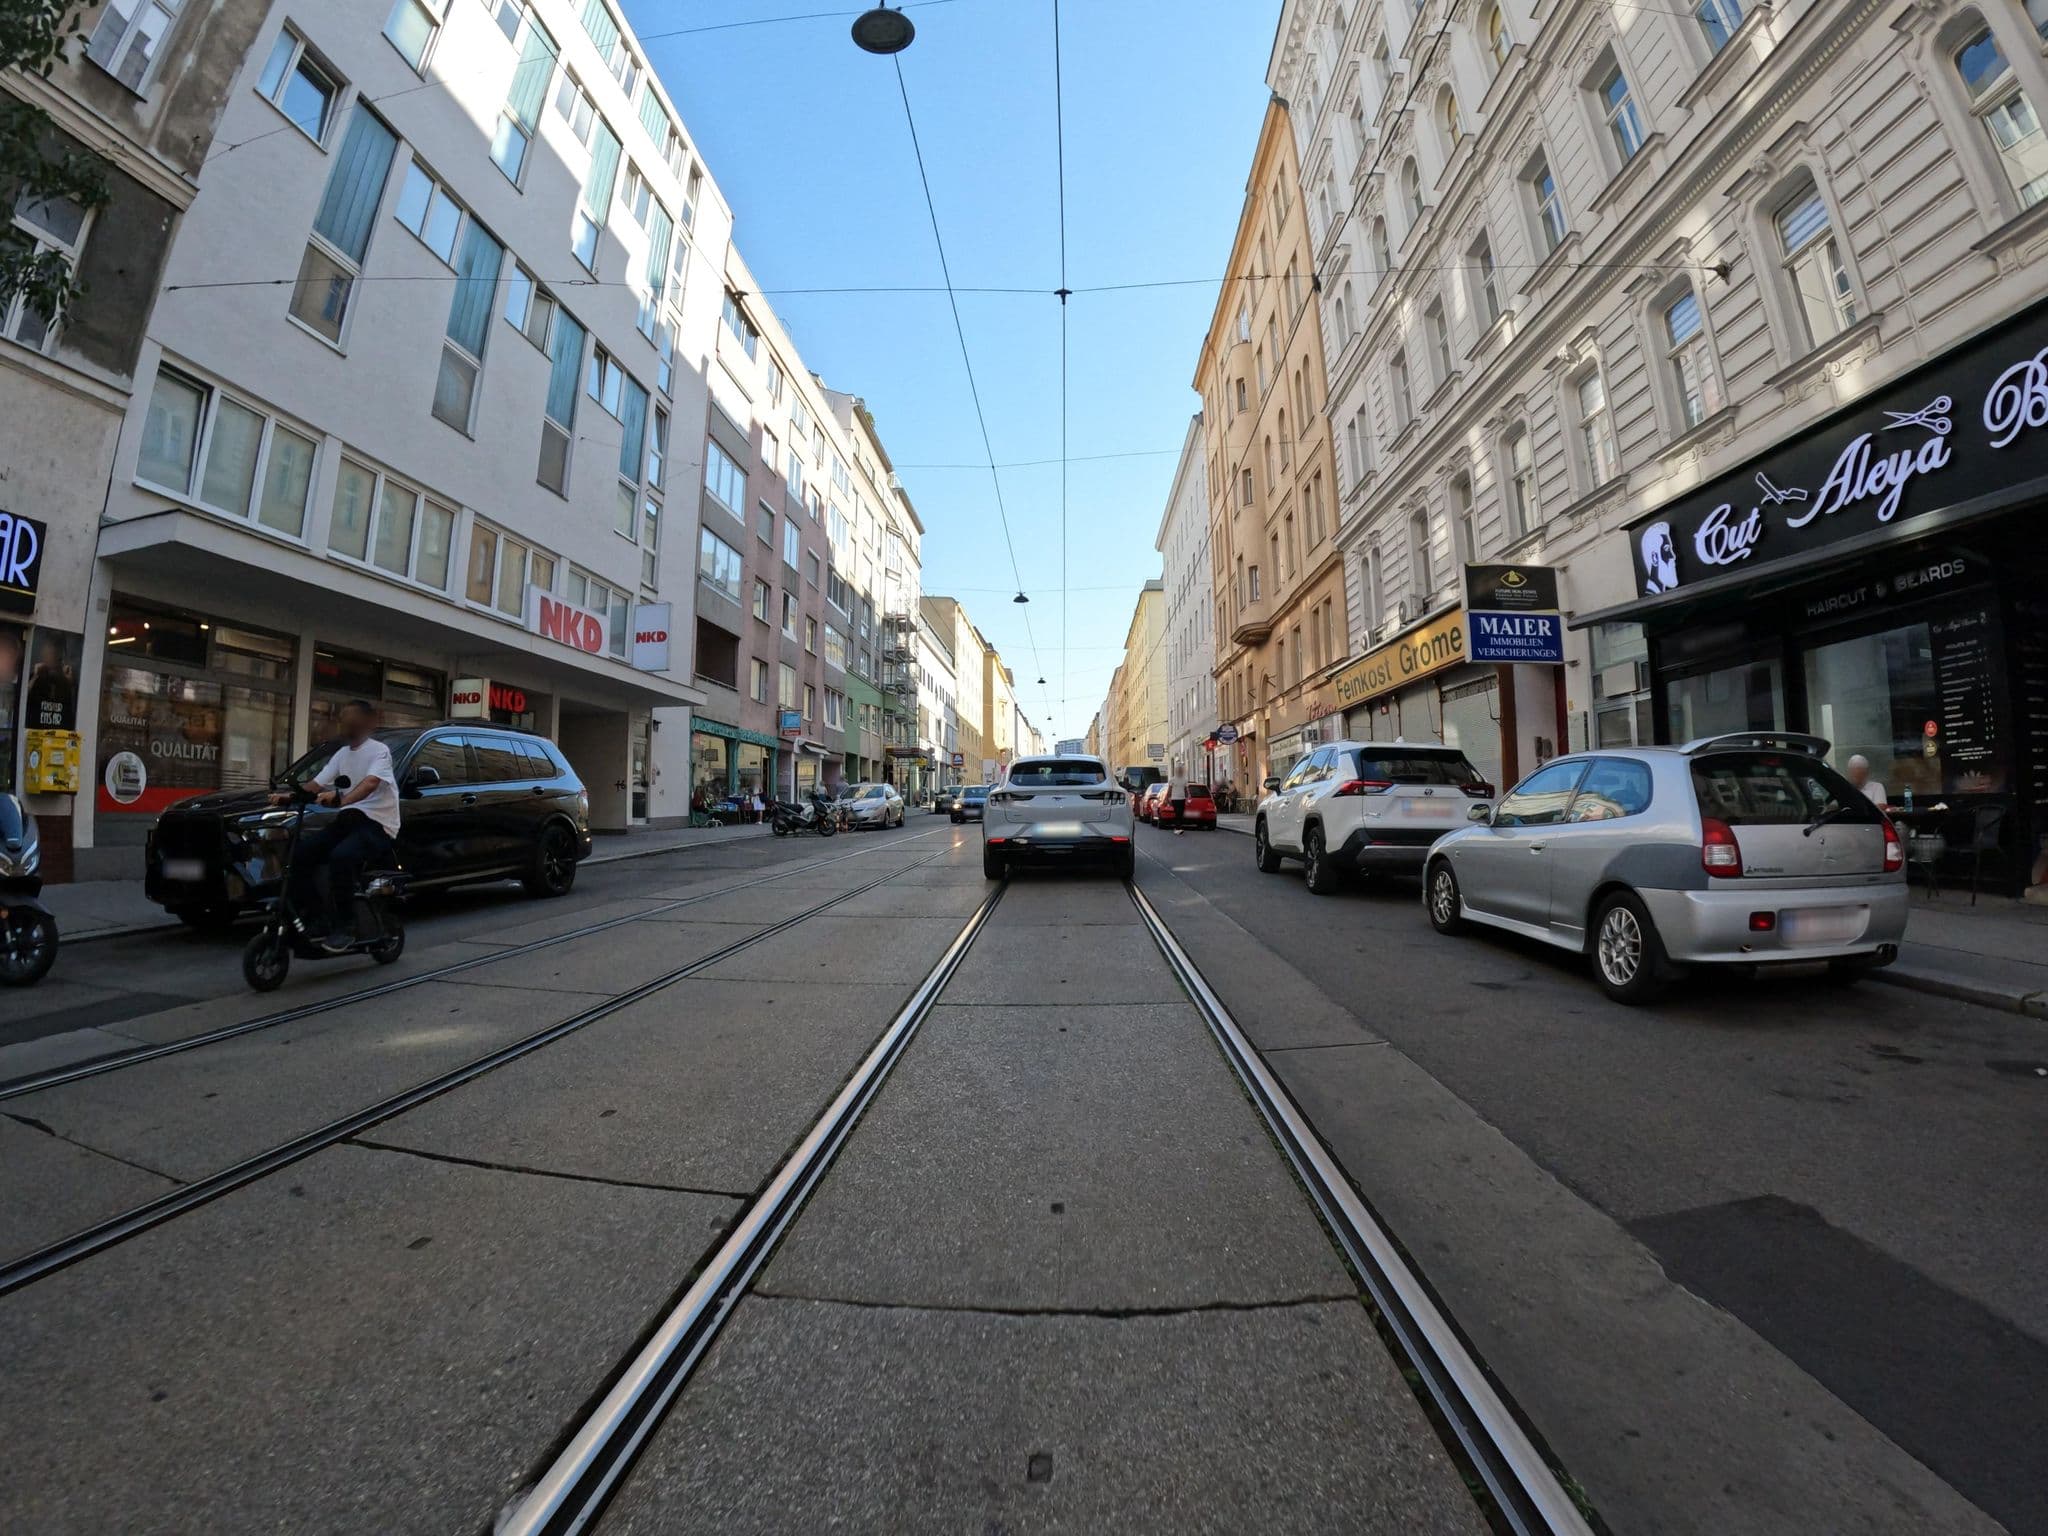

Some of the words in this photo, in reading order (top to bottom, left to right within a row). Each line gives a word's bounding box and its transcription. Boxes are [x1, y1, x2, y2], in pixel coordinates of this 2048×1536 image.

[1694, 503, 1763, 565] Cut
[1786, 432, 1952, 529] Aleya
[1807, 587, 1867, 617] HAIRCUT
[1894, 558, 1966, 593] BEARDS
[539, 594, 603, 655] NKD
[1479, 616, 1553, 636] MAIER
[635, 630, 668, 644] NKD
[1490, 637, 1544, 647] IMMOBILIEN
[1477, 647, 1557, 657] VERSICHERUNGEN
[1335, 657, 1393, 704] Feinkost
[1398, 625, 1463, 676] Grome
[452, 691, 481, 705] NKD
[489, 686, 527, 713] NKD
[150, 739, 220, 761] QUALITÄT
